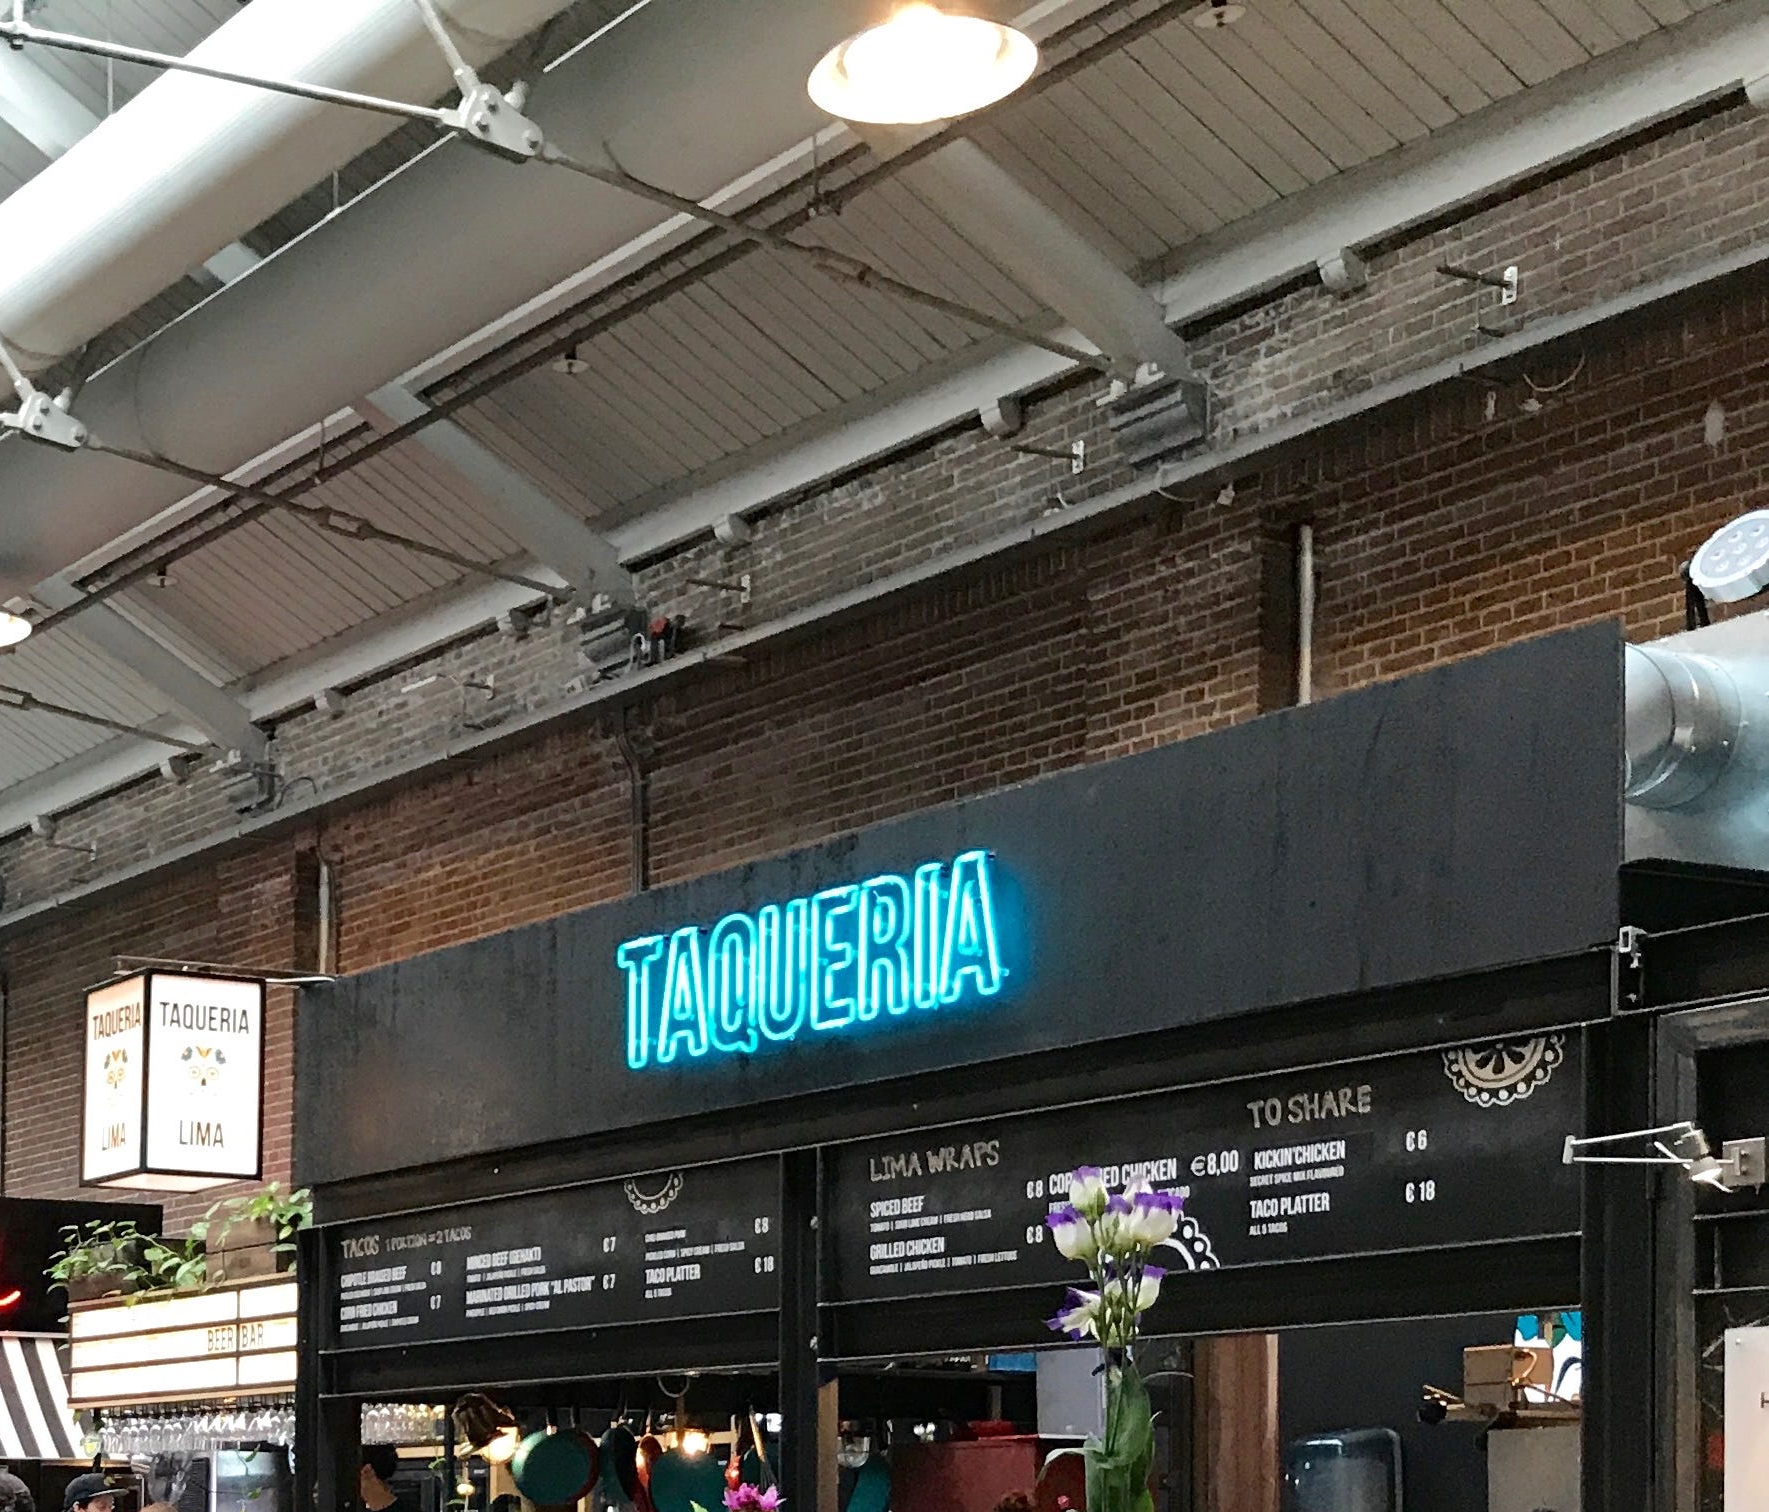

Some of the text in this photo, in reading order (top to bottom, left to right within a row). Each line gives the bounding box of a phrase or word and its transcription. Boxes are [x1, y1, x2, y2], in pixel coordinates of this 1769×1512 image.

[617, 850, 1003, 1070] TAQUERIA
[93, 1002, 142, 1040] TAQUERIA
[159, 1001, 250, 1034] TAQUERIA
[1247, 1084, 1373, 1128] TO SHARE
[102, 1122, 126, 1150] LIMA
[179, 1119, 224, 1148] LIMA
[869, 1139, 1000, 1182] LIMA WRAPS
[1121, 1157, 1178, 1187] CHICKEN
[870, 1195, 926, 1218] SPICED BEEF
[1249, 1192, 1331, 1219] TACO PLATTER
[340, 1235, 380, 1259] TACOS
[869, 1236, 946, 1261] GRILLED CHICKEN
[645, 1263, 701, 1285] TACO PLATTER
[207, 1323, 264, 1352] BEER BAR
